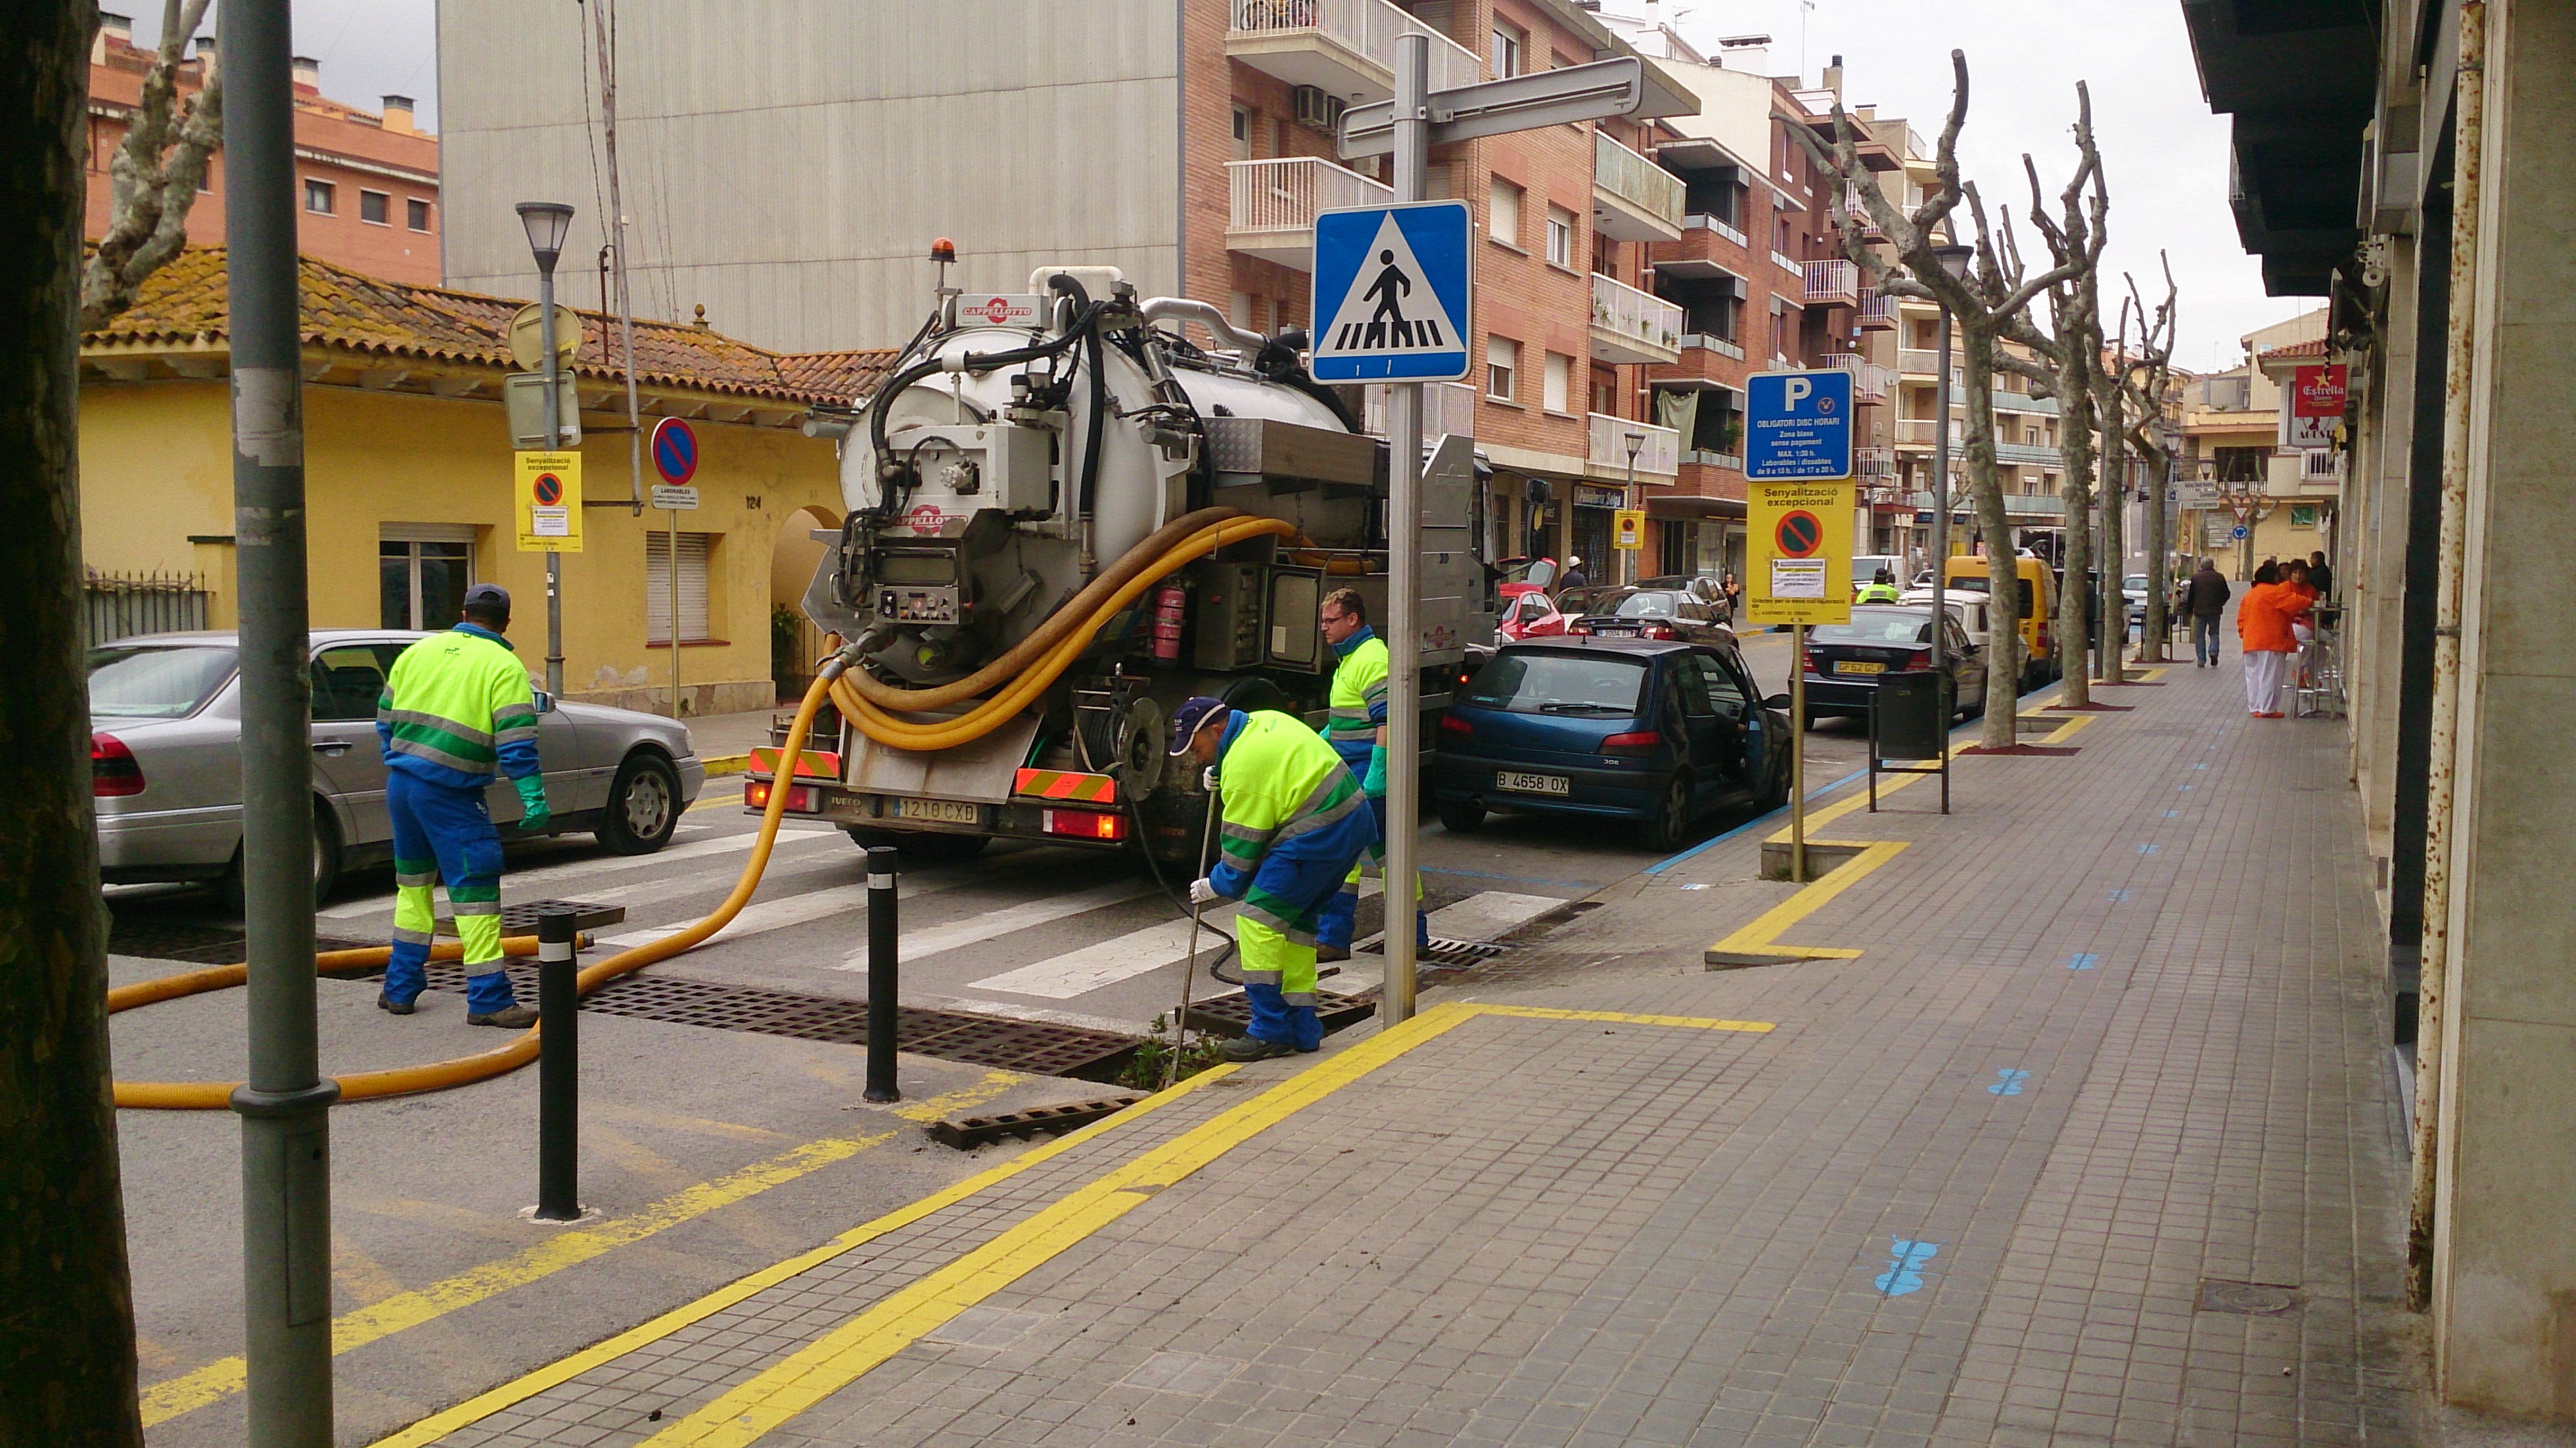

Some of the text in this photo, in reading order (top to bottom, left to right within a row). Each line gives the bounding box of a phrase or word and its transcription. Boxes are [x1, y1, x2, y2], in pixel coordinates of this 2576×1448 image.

[1785, 377, 1812, 412] P
[2303, 385, 2344, 396] Estrella
[1757, 417, 1840, 428] OBLIGATORI DISC HORARI
[1791, 438, 1822, 447] pagament
[526, 457, 572, 466] Senyalització
[1764, 487, 1839, 498] Senyalització
[746, 495, 762, 510] 124
[1767, 497, 1834, 508] excepcional
[1498, 773, 1568, 792] B 4658 OX
[831, 796, 861, 807] IVECO
[903, 800, 973, 821] 1210 CXD
